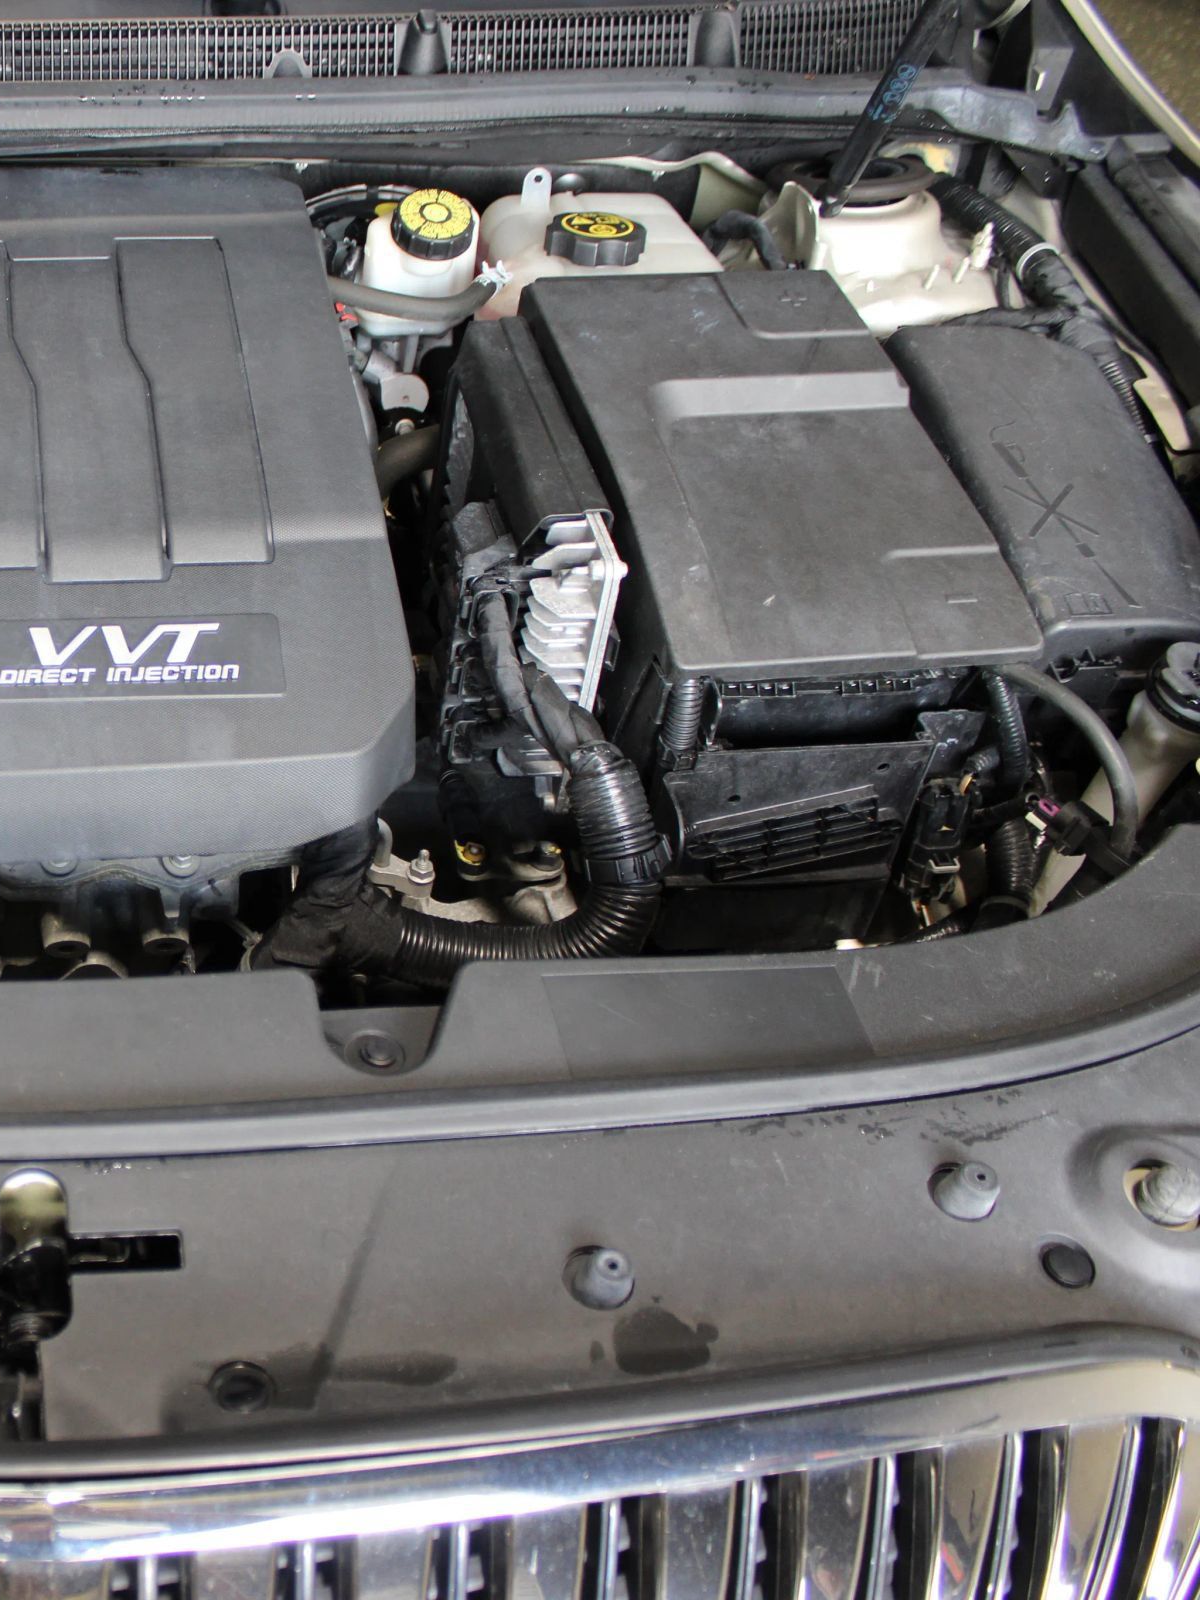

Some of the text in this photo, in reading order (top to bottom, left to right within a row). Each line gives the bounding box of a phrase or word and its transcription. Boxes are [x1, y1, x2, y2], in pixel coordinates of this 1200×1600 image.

[29, 622, 221, 666] VVT
[0, 663, 240, 685] DIRECT INJECTION
